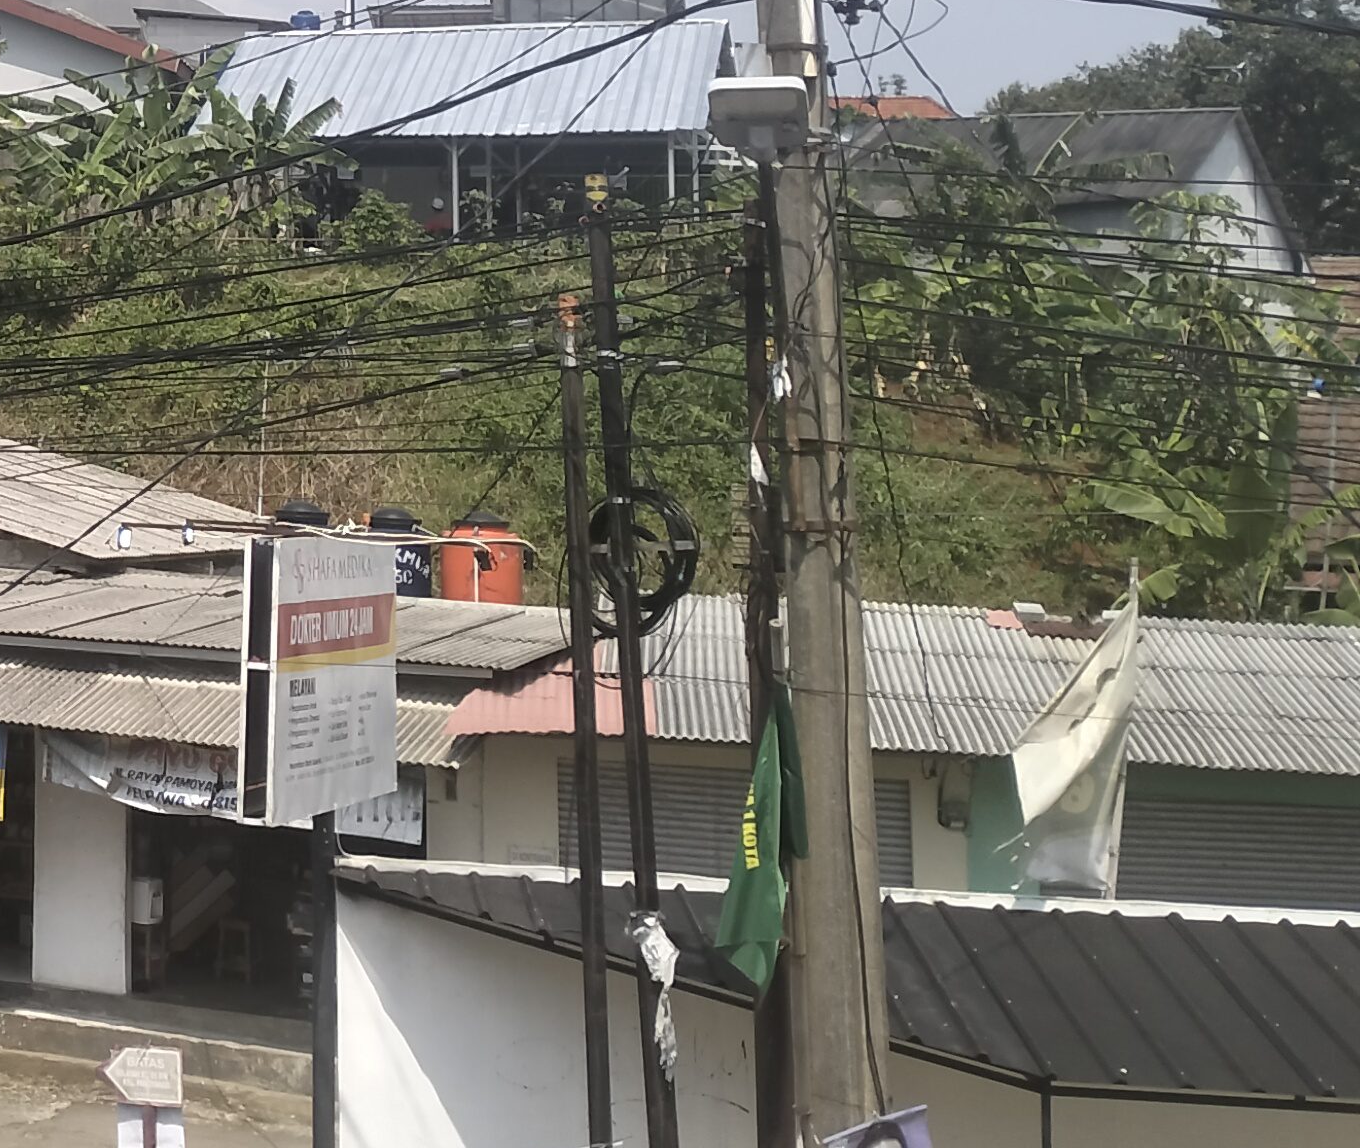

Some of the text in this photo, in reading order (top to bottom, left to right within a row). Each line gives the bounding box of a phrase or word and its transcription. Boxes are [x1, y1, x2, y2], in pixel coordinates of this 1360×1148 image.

[339, 554, 373, 580] MEDIKA
[290, 612, 321, 645] DOKTER
[323, 609, 349, 641] UMUM
[359, 606, 373, 636] JAM
[742, 822, 760, 869] KOTA
[127, 1056, 165, 1069] BATAS
